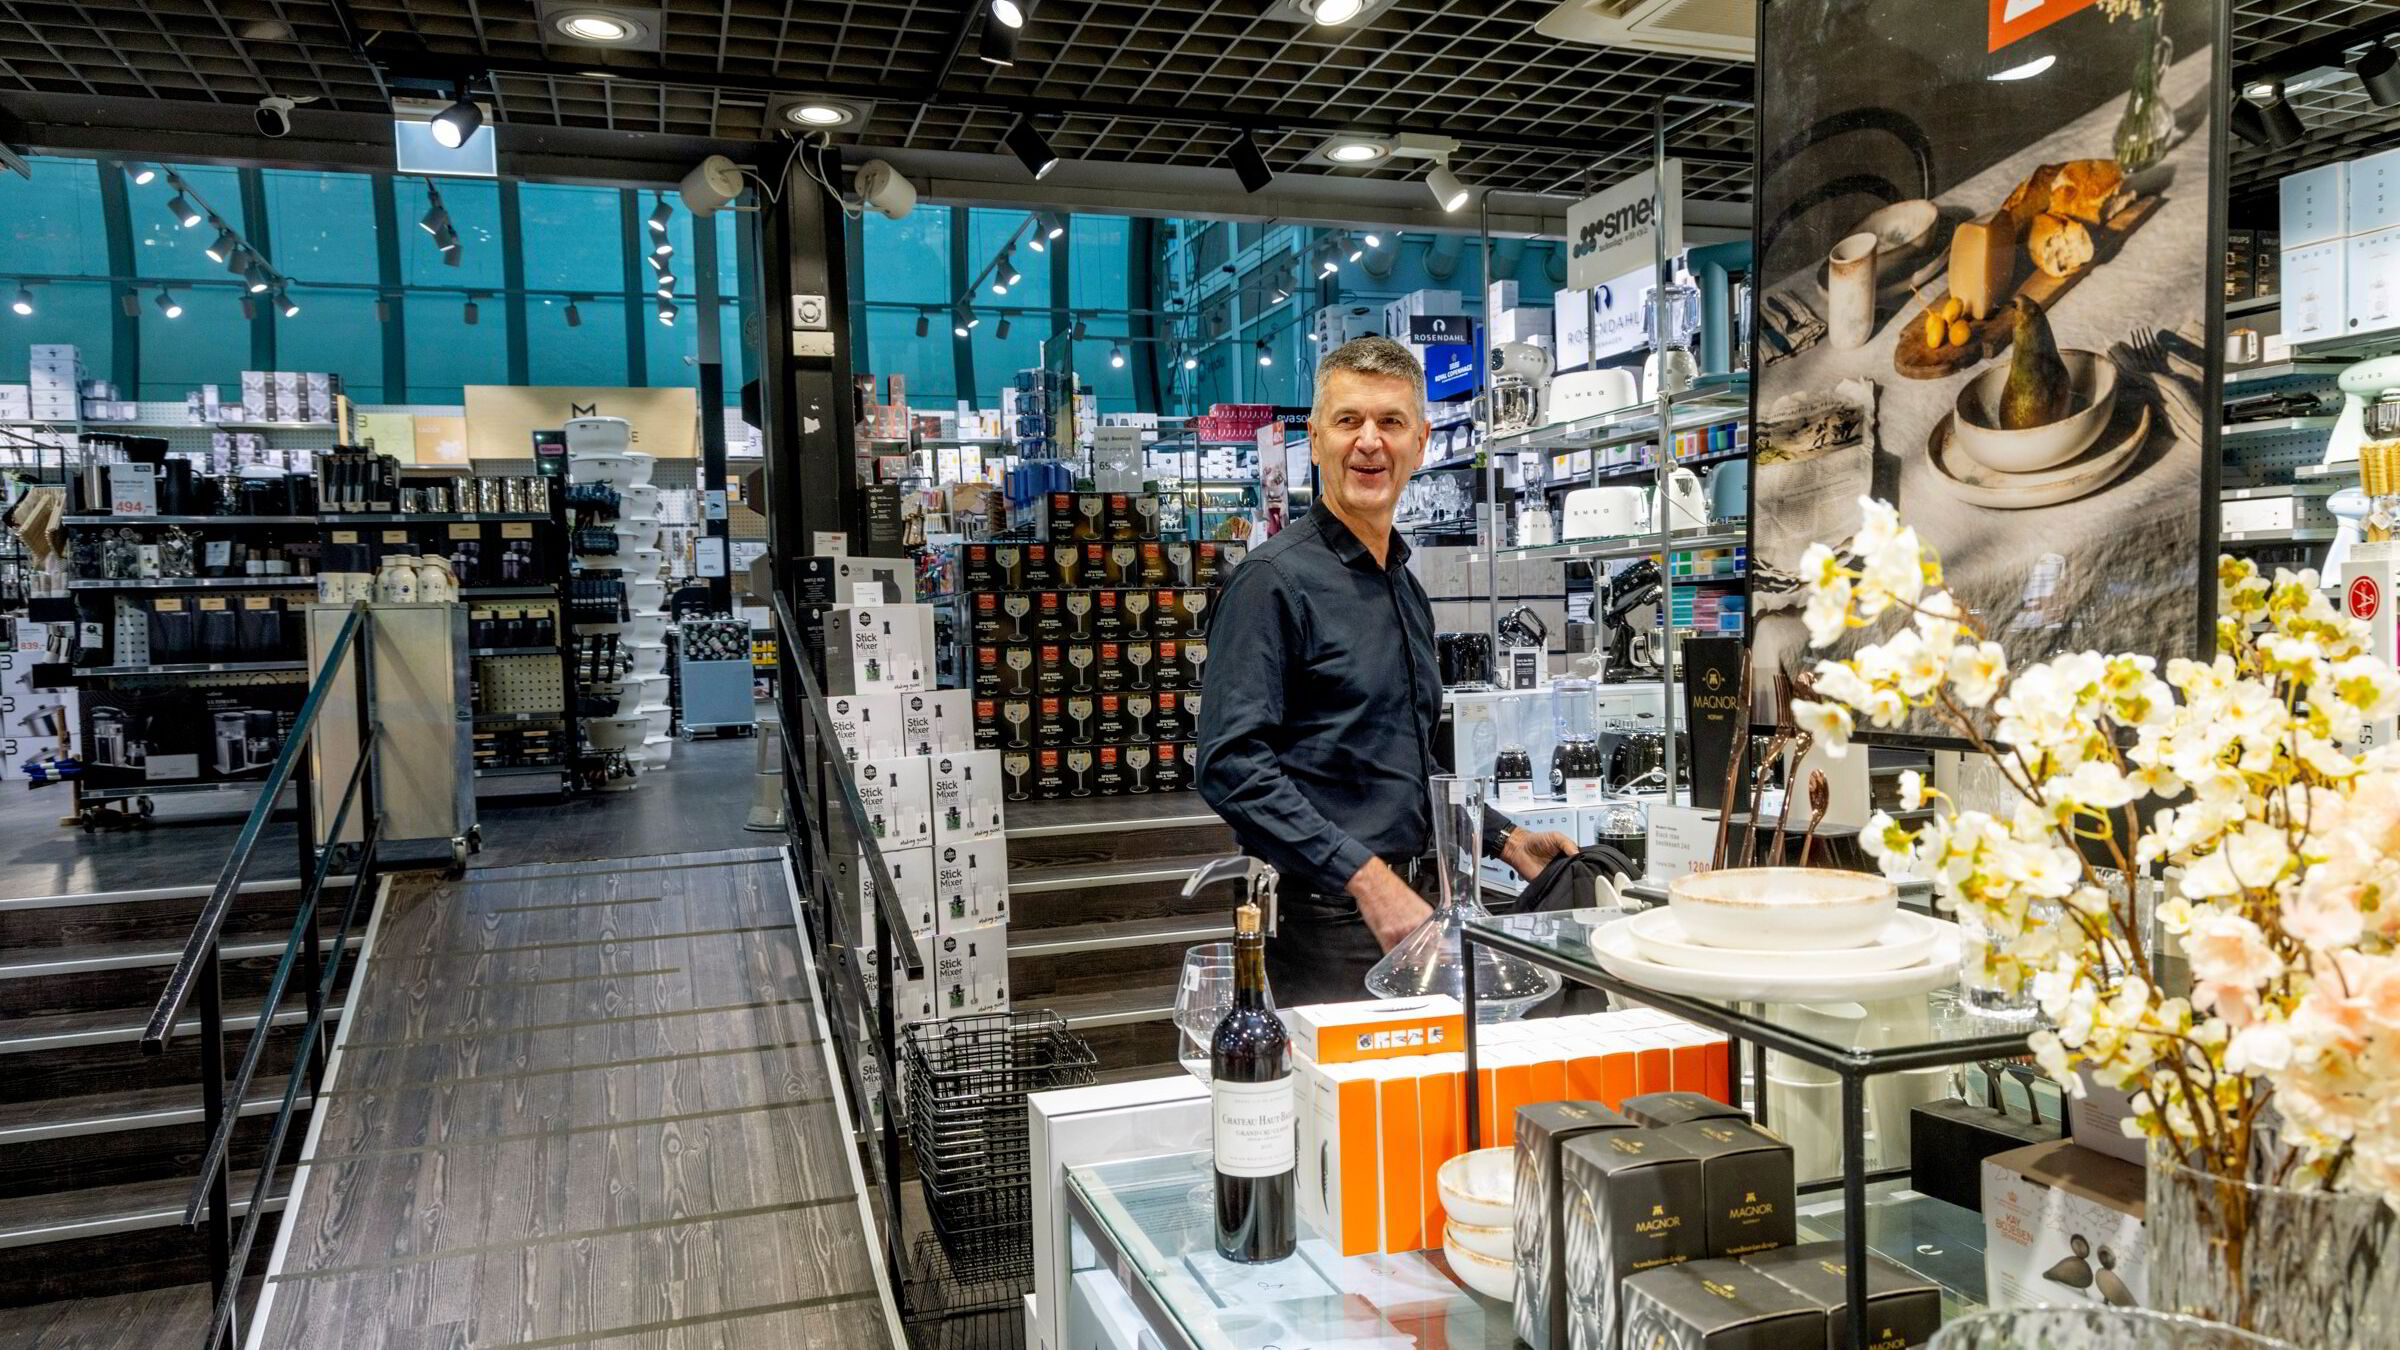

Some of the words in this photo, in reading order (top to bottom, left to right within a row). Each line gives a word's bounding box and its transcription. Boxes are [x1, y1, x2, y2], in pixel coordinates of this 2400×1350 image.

[1414, 334, 1465, 342] ROSENDAHL
[856, 632, 877, 643] Stick
[856, 642, 878, 650] Mixer
[1693, 695, 1739, 710] MAGNOR
[833, 721, 856, 731] Stick
[907, 717, 929, 727] Stick
[907, 727, 930, 735] Mixer
[936, 780, 958, 791] Stick
[860, 787, 883, 798] Stick
[936, 789, 959, 799] Mixer
[1525, 816, 1567, 826] SMEG
[940, 869, 962, 880] Stick
[940, 878, 963, 888] Mixer
[940, 958, 962, 970] Stick
[940, 968, 963, 977] Mixer
[863, 973, 878, 983] Stic
[1729, 1203, 1773, 1219] MAGNOR
[2006, 1213, 2020, 1224] KAY
[1635, 1216, 1681, 1233] MAGNOR
